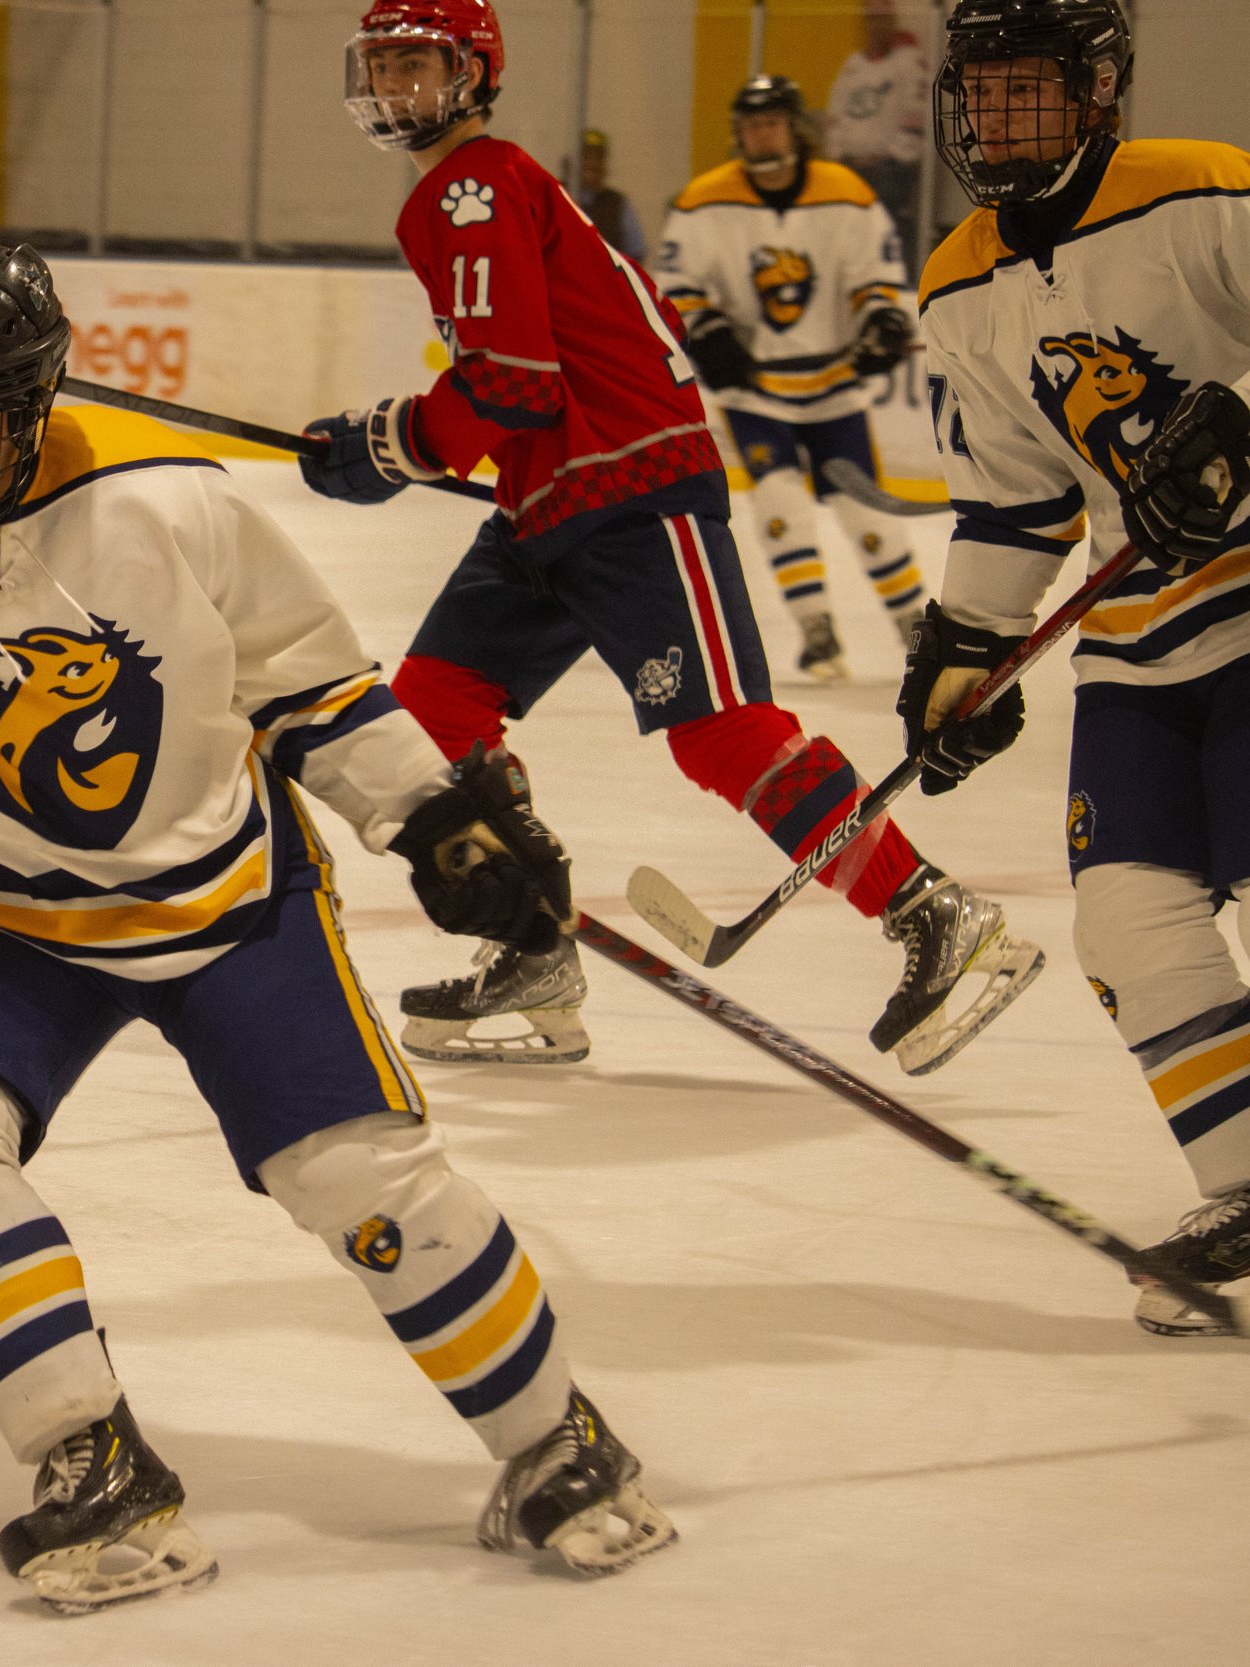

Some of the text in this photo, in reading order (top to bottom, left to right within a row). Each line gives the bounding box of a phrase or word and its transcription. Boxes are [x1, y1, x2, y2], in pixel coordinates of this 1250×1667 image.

[451, 255, 493, 318] 11
[778, 804, 863, 903] BAUER
[936, 938, 950, 980] AUER
